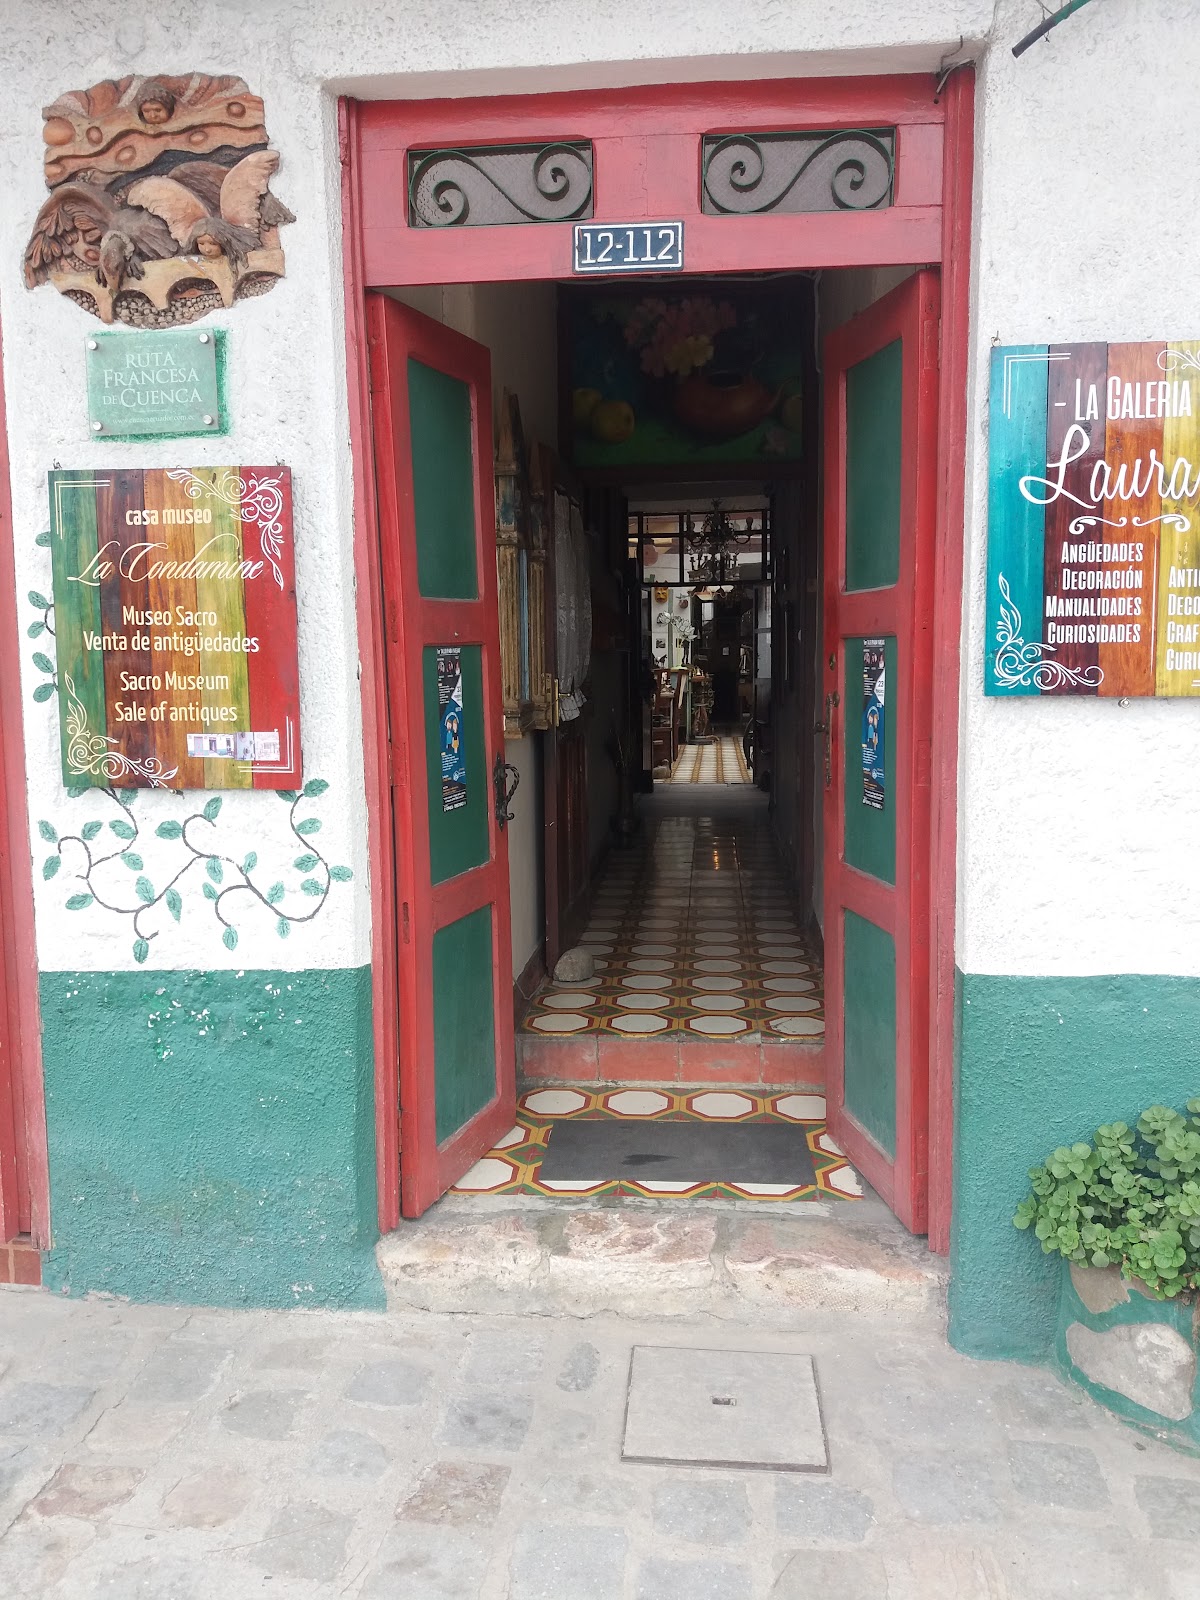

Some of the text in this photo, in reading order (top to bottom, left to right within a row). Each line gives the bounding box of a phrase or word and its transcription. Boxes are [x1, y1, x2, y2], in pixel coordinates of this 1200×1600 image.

[581, 229, 675, 264] 12-112
[125, 351, 176, 368] RUTA
[103, 367, 200, 389] FRANCESA
[103, 387, 203, 408] DE CUENCA
[1075, 375, 1192, 421] LA GALERIA
[1018, 423, 1200, 510] Laura
[125, 507, 212, 526] casa museo
[66, 533, 264, 587] La Condamine
[1060, 540, 1144, 564] ANGÜEDADES
[1062, 565, 1143, 591] DECORACIÓN
[1168, 565, 1200, 588] ANTI
[122, 605, 217, 627] Museo Sacro
[1045, 595, 1142, 618] MANUALIDADES
[83, 630, 260, 657] Venta de antigüedades
[1047, 621, 1141, 644] CURIOSIDADES
[120, 671, 229, 692] Sacro Museum
[115, 700, 238, 727] Sale of antiques
